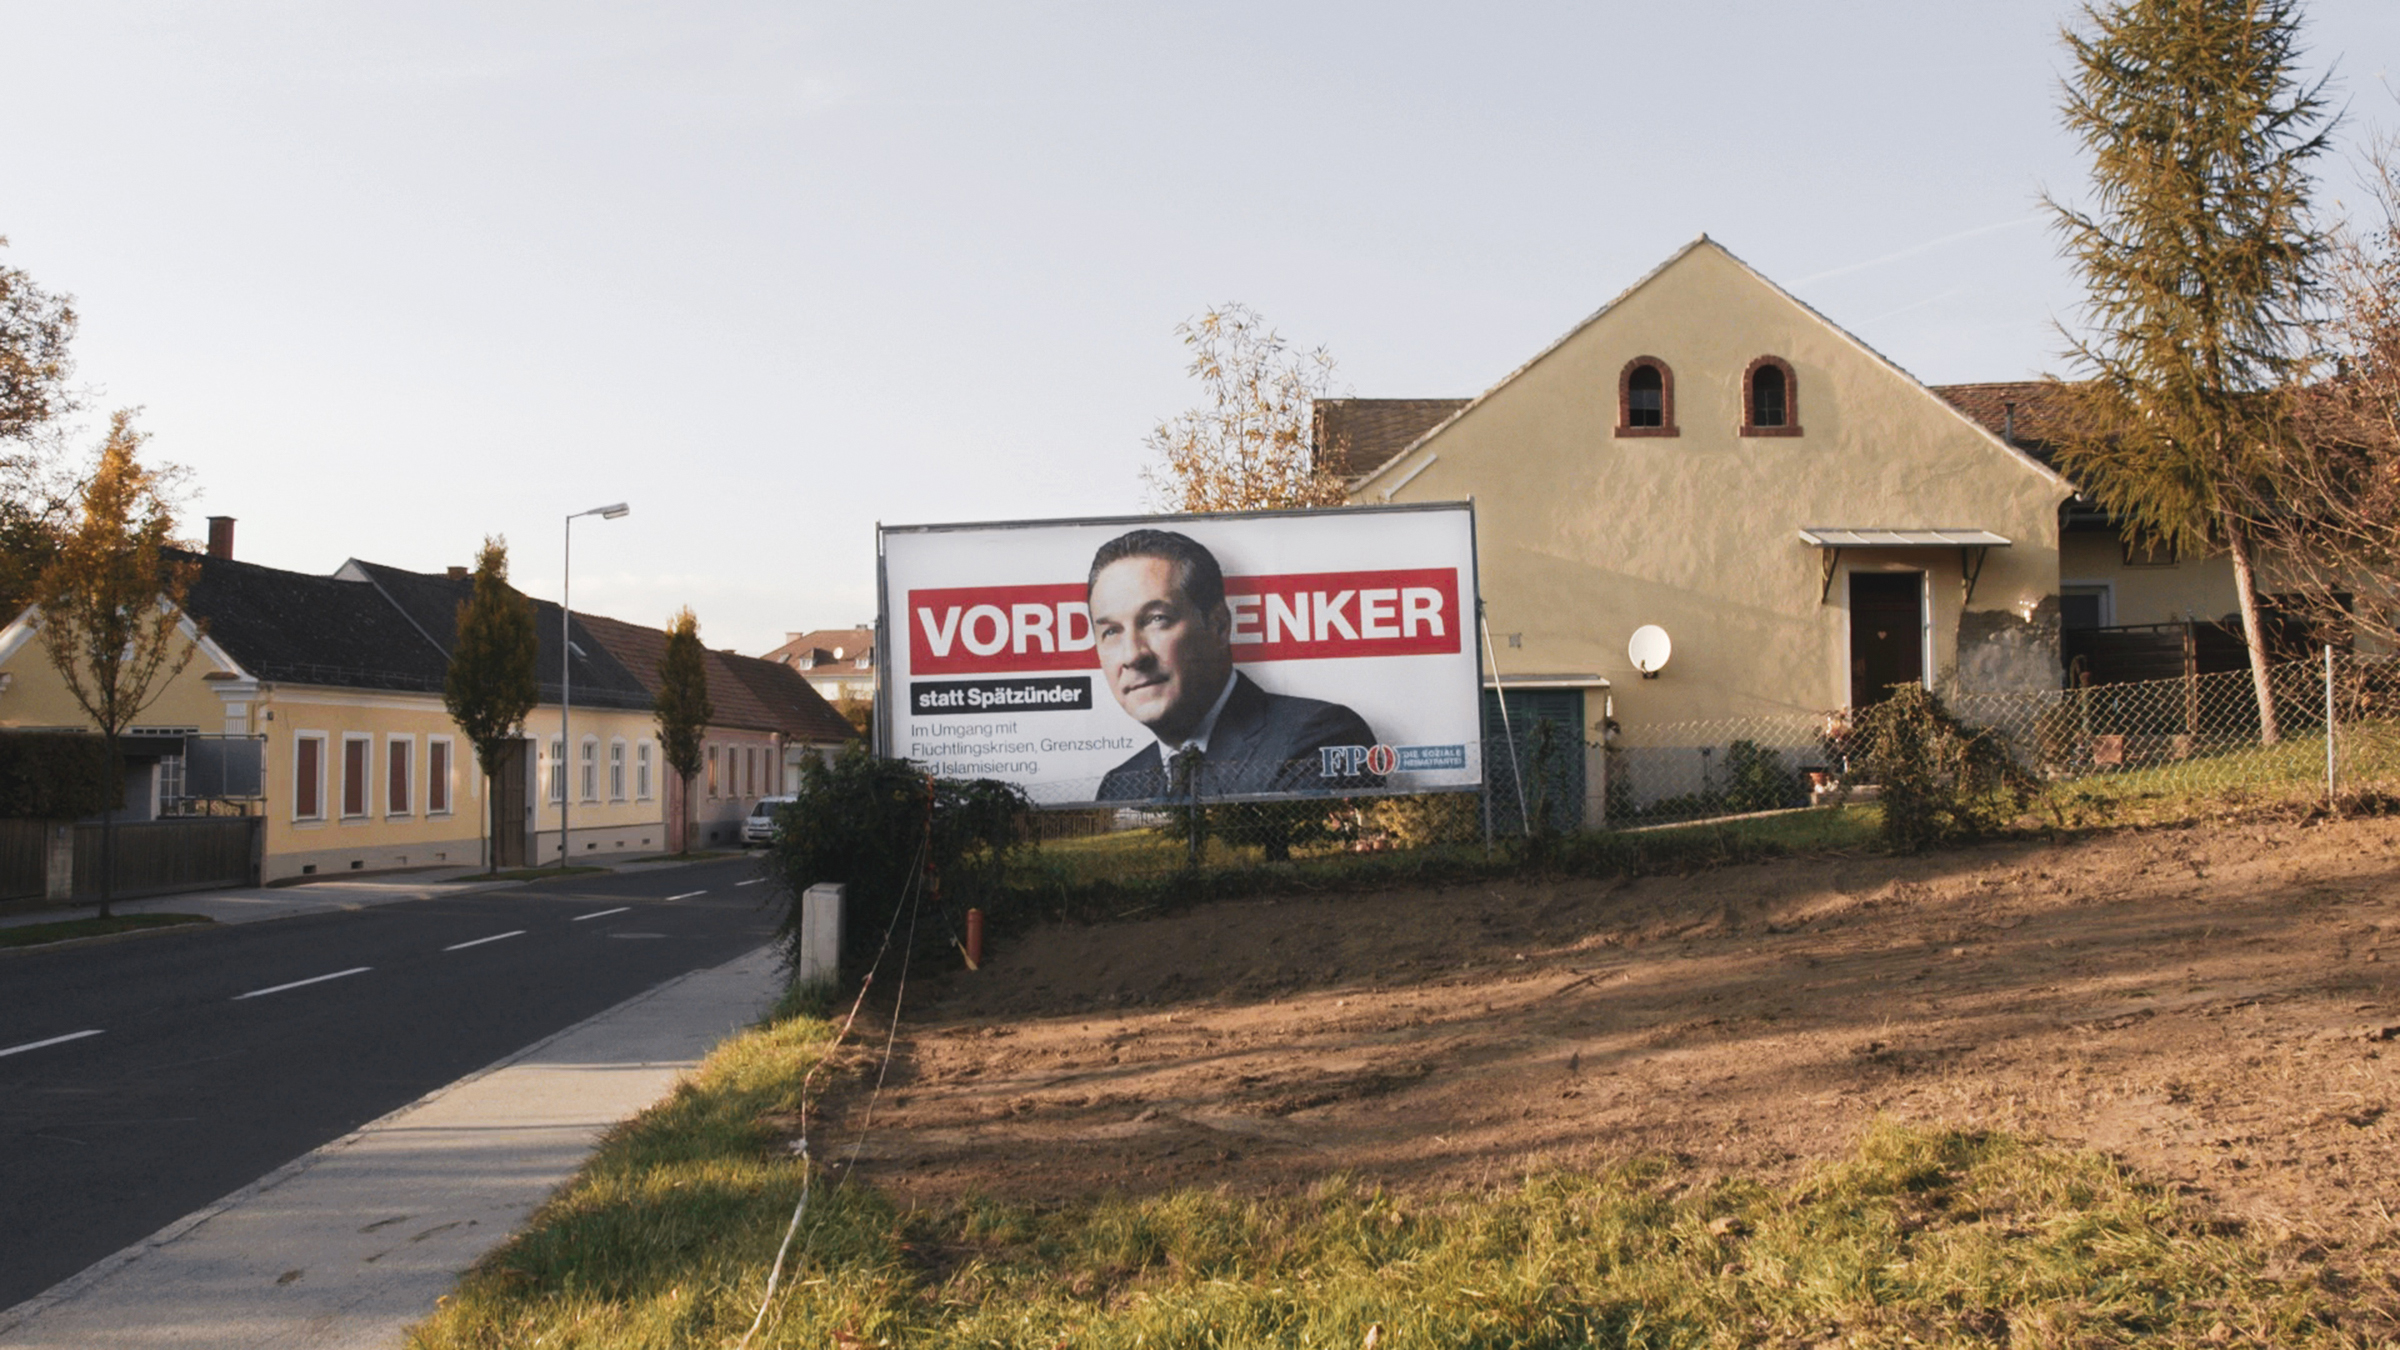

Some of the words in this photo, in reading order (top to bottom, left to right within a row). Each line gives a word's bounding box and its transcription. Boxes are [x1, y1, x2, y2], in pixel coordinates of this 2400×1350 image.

[919, 690, 965, 707] statt
[967, 685, 1082, 708] Spätzünder
[911, 724, 929, 737] Im
[931, 723, 993, 739] Umgang
[995, 721, 1018, 734] mit
[911, 740, 1038, 758] Flüchtlingskrisen,
[1040, 736, 1134, 753] Grenzschutz
[942, 760, 1041, 775] Islamisierung.
